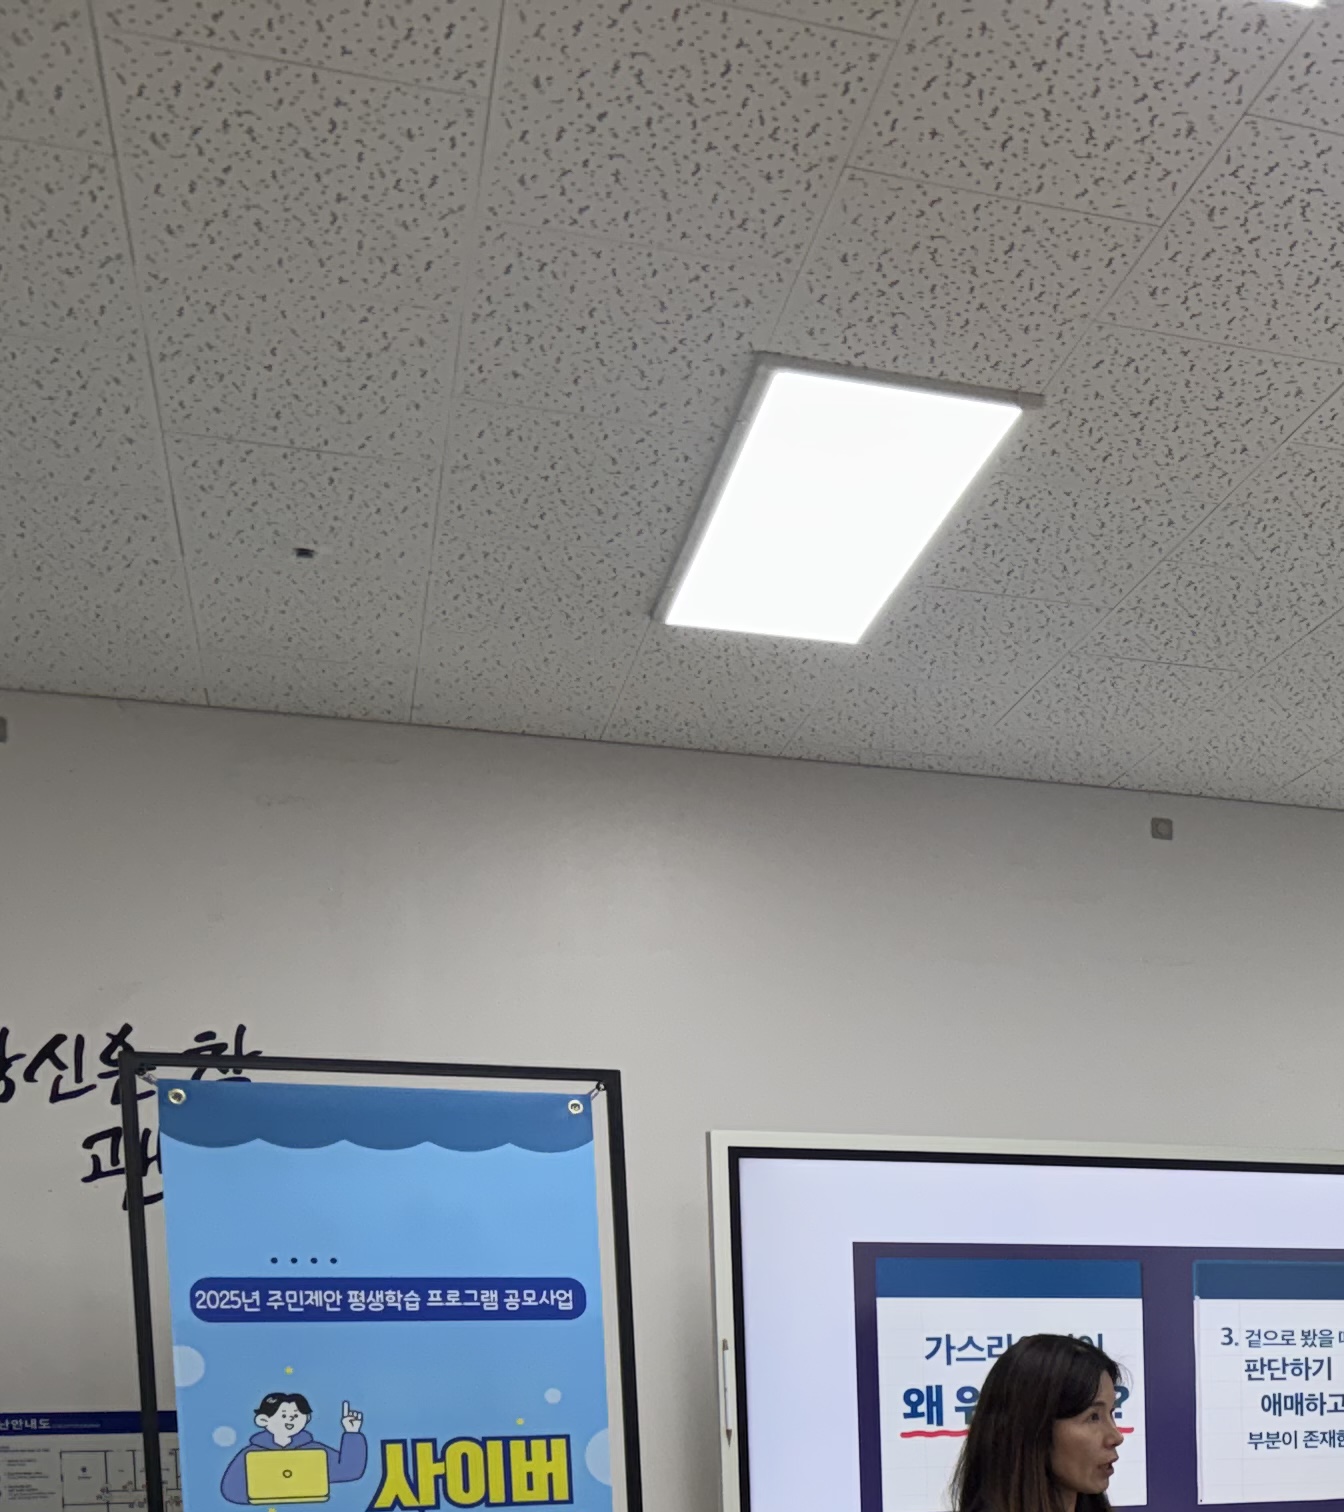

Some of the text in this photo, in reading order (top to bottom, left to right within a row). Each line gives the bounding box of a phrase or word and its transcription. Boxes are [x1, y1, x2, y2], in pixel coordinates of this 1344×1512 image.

[195, 1289, 574, 1312] 2025년 주민제안 평생학습 프로그램 공모사업
[1220, 1327, 1239, 1346] 3.
[1245, 1328, 1297, 1348] 겉으로
[1300, 1328, 1335, 1348] 봤을
[1244, 1356, 1332, 1382] 판단하기
[903, 1384, 944, 1427] 왜
[1247, 1430, 1298, 1450] 부분이
